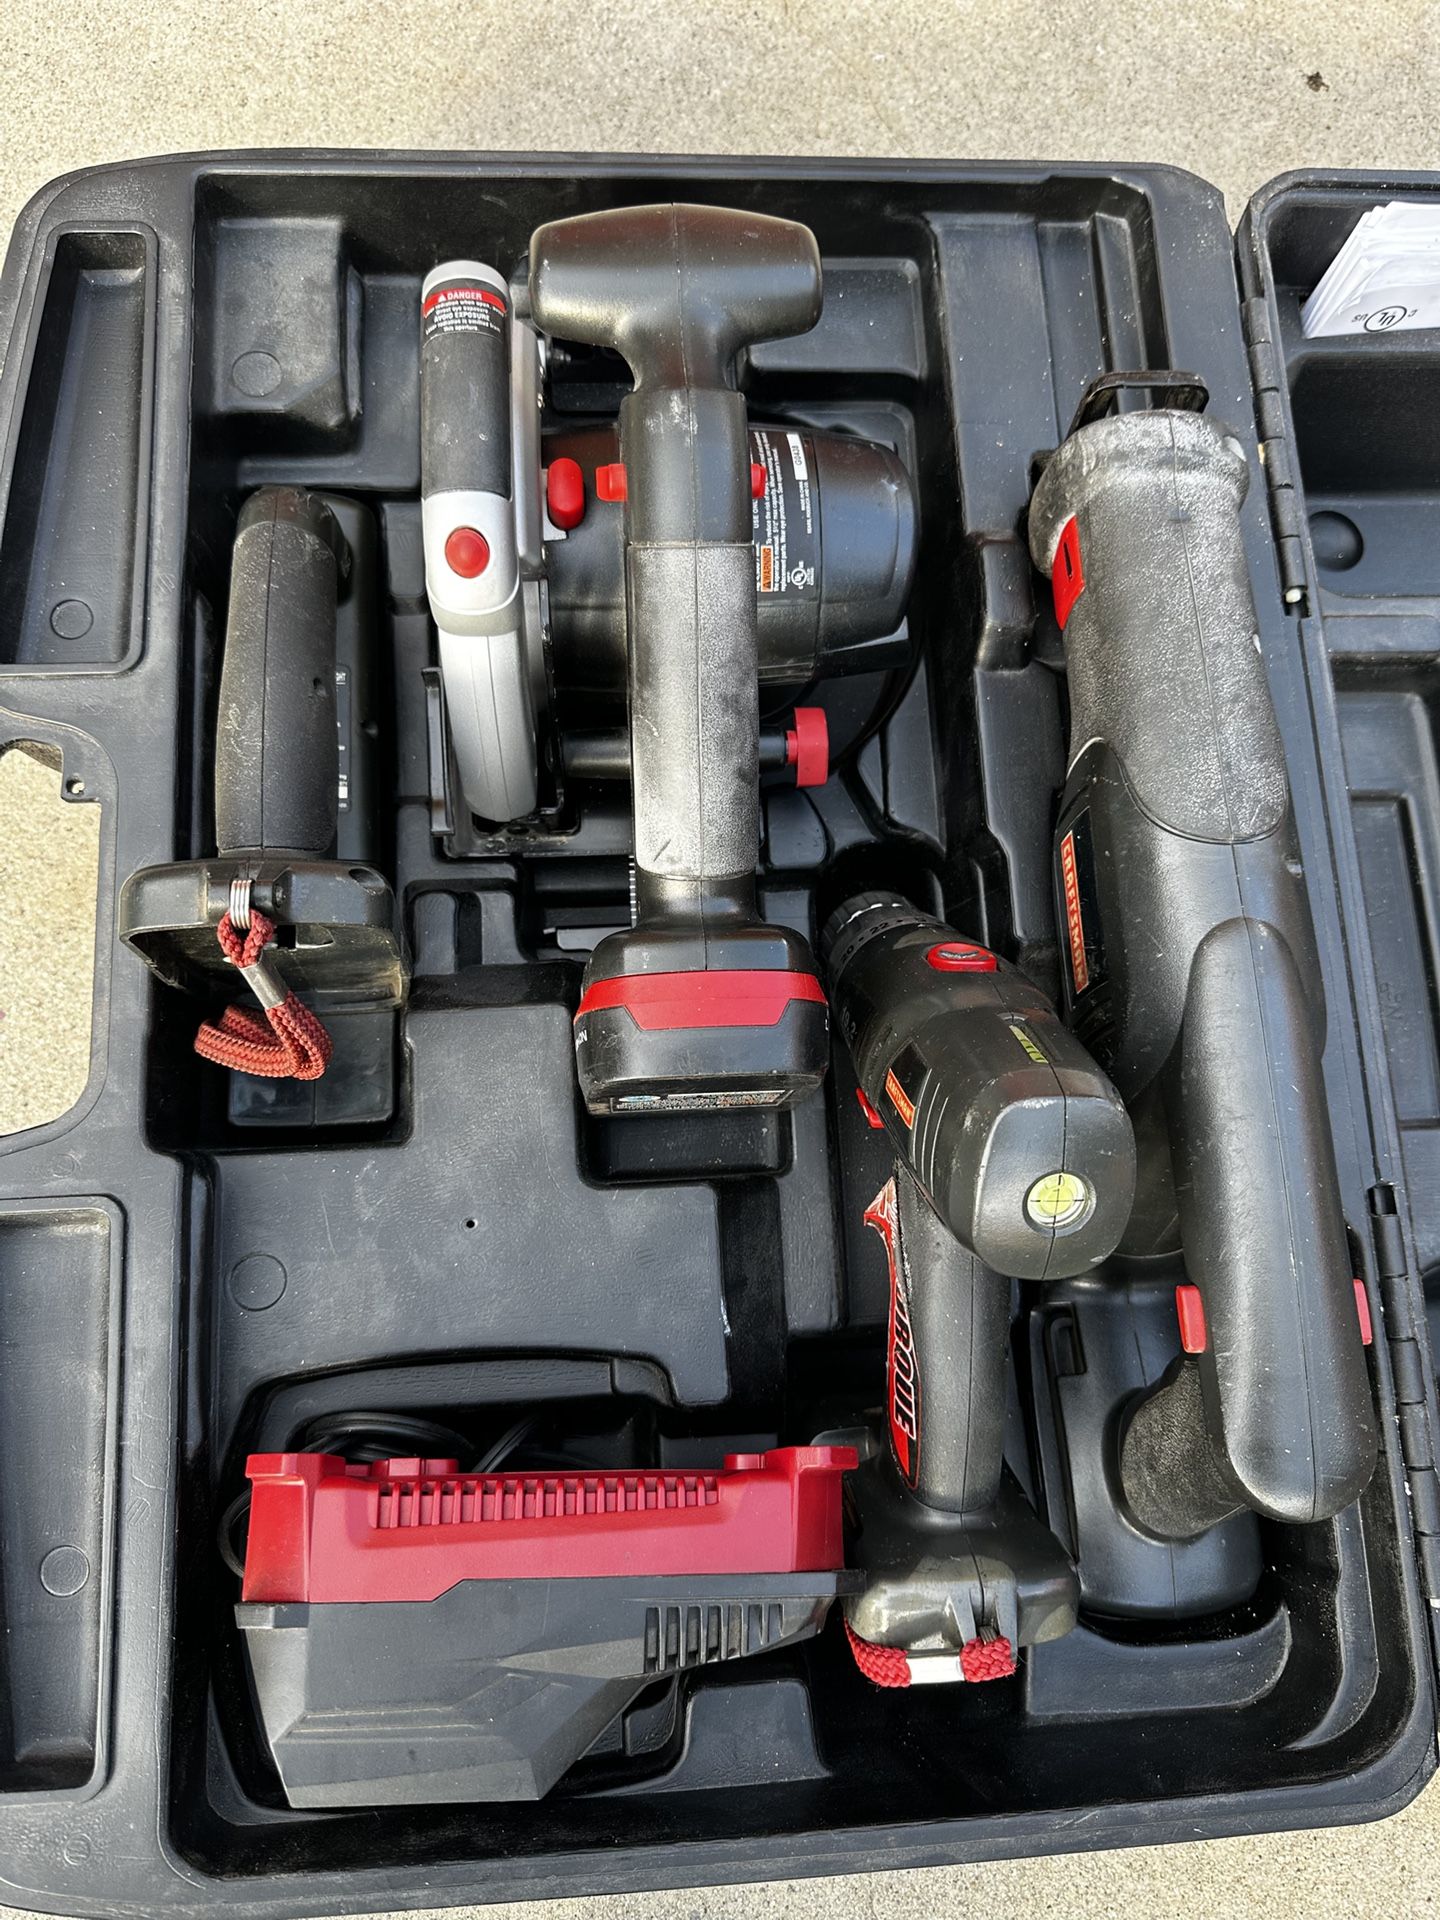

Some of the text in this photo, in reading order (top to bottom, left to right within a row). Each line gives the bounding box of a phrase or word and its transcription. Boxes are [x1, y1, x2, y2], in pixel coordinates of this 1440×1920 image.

[447, 292, 482, 300] DANGER
[434, 312, 453, 323] AVOID
[455, 311, 490, 321] EXPOSURE
[1377, 311, 1396, 326] UL
[792, 445, 803, 465] G0438
[1063, 843, 1085, 984] CRAFTSMAN
[870, 922, 889, 934] 22
[887, 1073, 913, 1125] CRAFTSMAN
